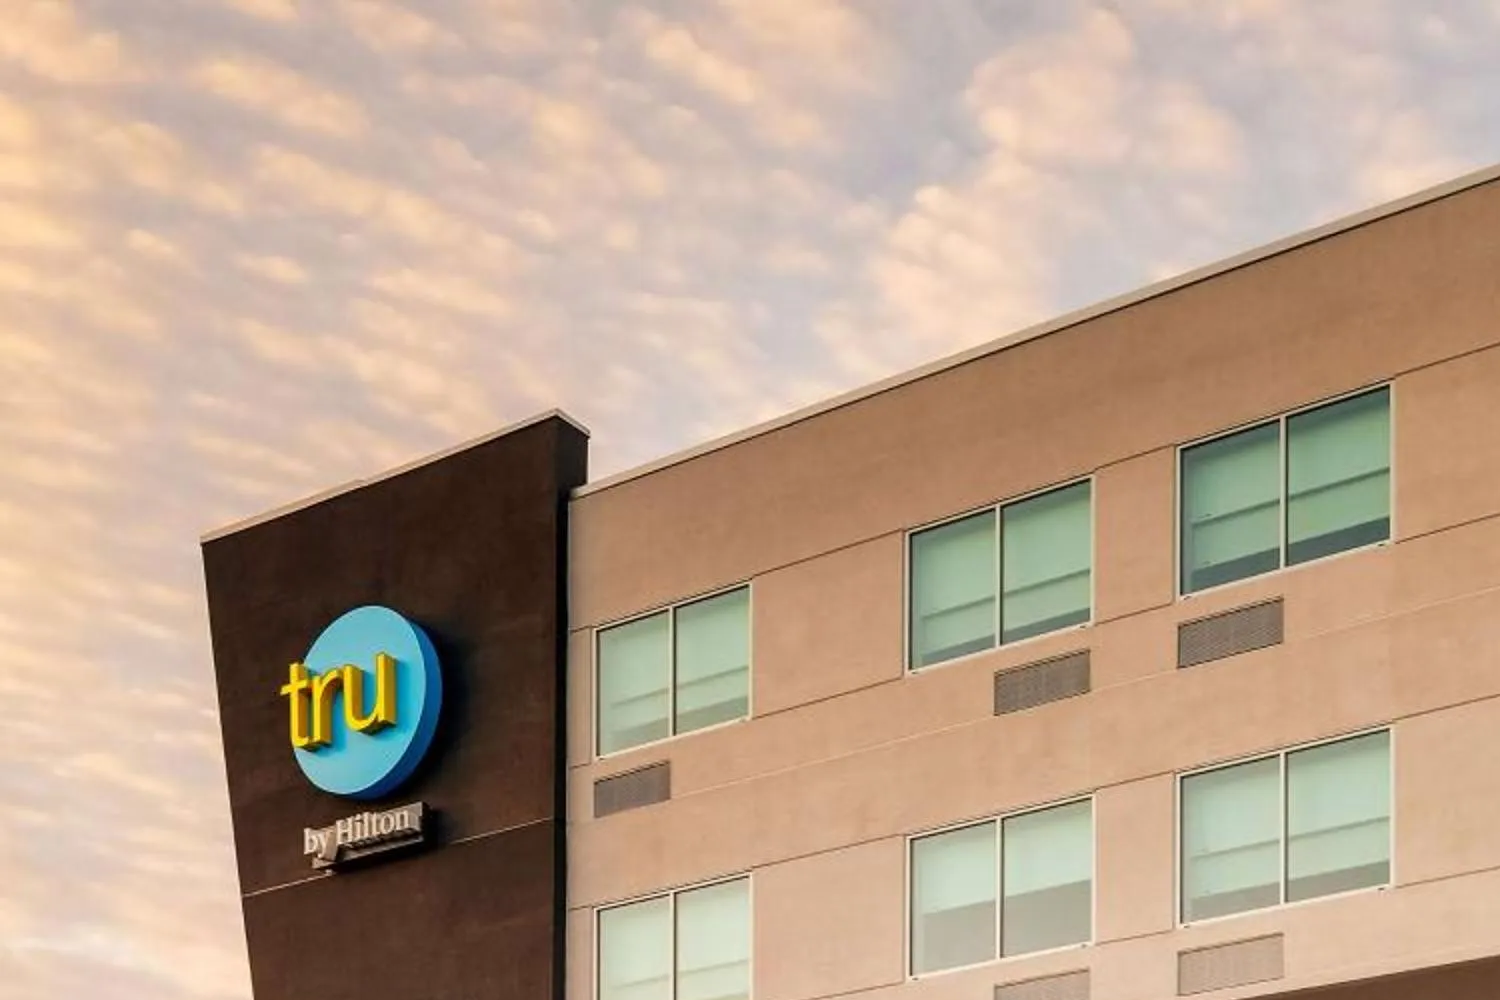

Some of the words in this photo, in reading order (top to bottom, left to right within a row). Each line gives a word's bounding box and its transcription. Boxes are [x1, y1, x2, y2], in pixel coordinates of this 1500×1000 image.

[280, 652, 396, 752] tru
[303, 826, 332, 859] by
[335, 808, 412, 845] Hilton
